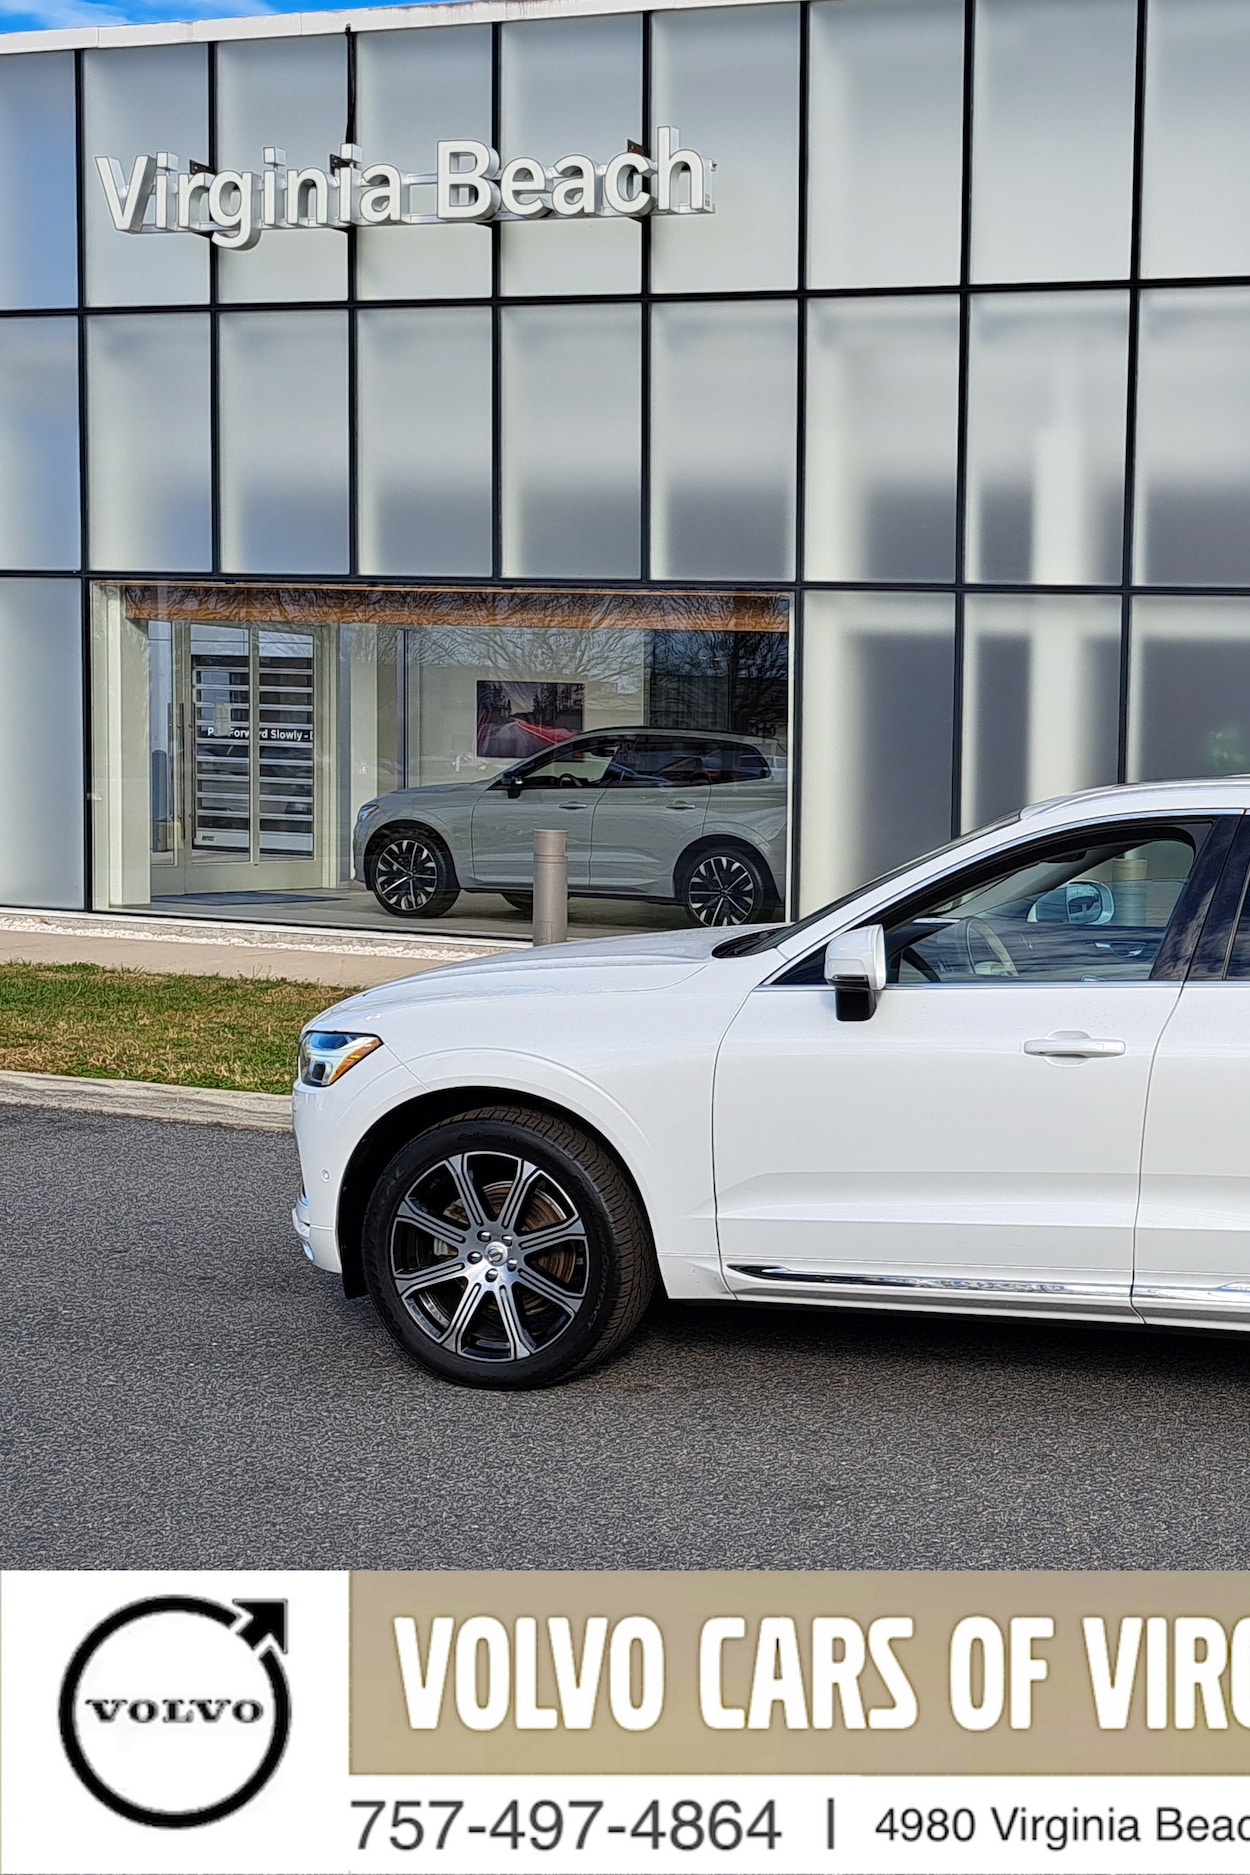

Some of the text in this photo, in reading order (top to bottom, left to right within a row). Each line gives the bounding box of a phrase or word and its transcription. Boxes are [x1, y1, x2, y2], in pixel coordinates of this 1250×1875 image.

[94, 125, 708, 250] Virginia Beach
[270, 729, 303, 741] Slowly
